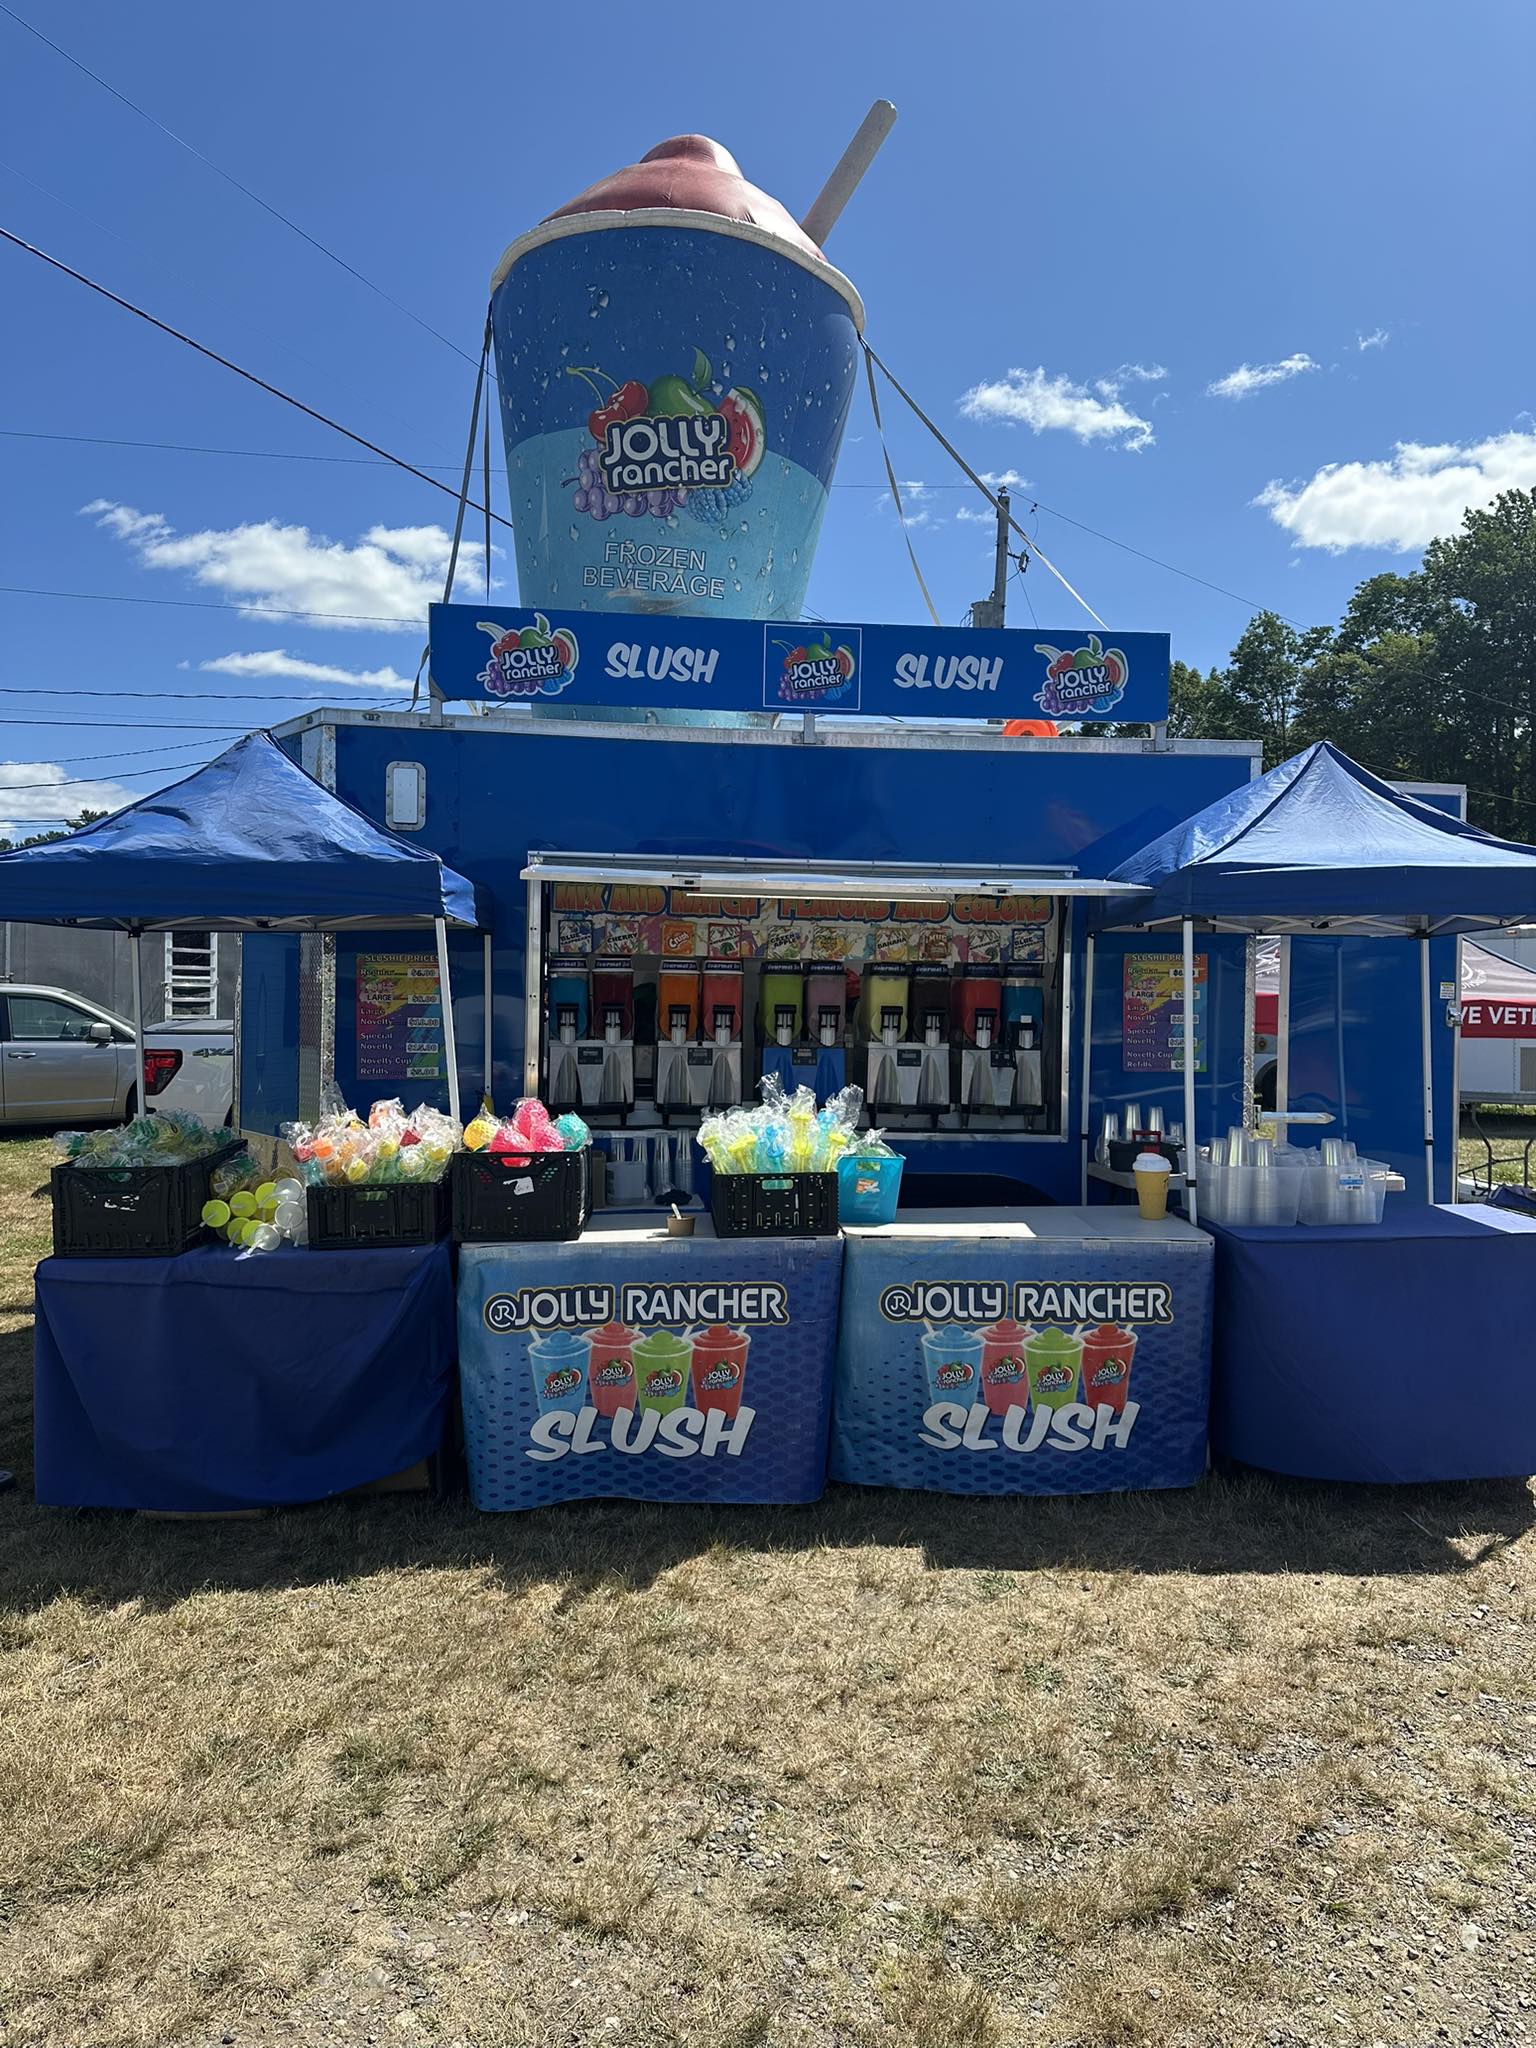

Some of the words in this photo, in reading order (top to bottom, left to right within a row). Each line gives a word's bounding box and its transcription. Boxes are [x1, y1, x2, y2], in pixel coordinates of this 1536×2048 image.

[605, 420, 720, 464] JOLLY
[612, 455, 730, 488] rancher
[604, 542, 706, 571] FROZEN
[583, 566, 725, 600] BEVERAGE
[501, 647, 556, 668] JOLLY
[604, 642, 720, 684] SLUSH
[505, 662, 560, 680] rancher
[789, 658, 838, 679] JOLLY
[893, 652, 1004, 691] SLUSH
[793, 673, 843, 691] rancher
[1055, 665, 1107, 688] JOLLY
[1059, 681, 1110, 699] rancher
[607, 885, 666, 912] AND
[895, 901, 949, 920] AND
[954, 894, 1050, 922] COLORS
[607, 933, 638, 943] CHERRY
[877, 937, 907, 949] BANANA
[360, 1017, 392, 1026] Novelty
[1127, 1014, 1156, 1023] Novelty
[360, 1032, 392, 1041] Special
[1127, 1027, 1156, 1036] Special
[360, 1043, 392, 1052] Novelty
[1127, 1038, 1156, 1046] Novelty
[1127, 1050, 1157, 1059] Novelty
[1157, 1051, 1173, 1060] Cup
[360, 1058, 392, 1066] Novelty
[395, 1057, 412, 1066] Cup
[360, 1067, 389, 1075] Refills
[514, 1290, 609, 1326] JOLLY
[626, 1287, 784, 1322] RANCHER
[910, 1286, 1002, 1318] JOLLY
[1018, 1286, 1169, 1319] RANCHER
[602, 1366, 624, 1376] JOLLY
[708, 1369, 731, 1380] JOLLY
[942, 1369, 965, 1380] JOLLY
[994, 1363, 1016, 1374] JOLLY
[1098, 1366, 1118, 1376] JOLLY
[550, 1375, 573, 1388] JOLLY
[651, 1376, 673, 1387] JOLLY
[1042, 1372, 1064, 1382] JOLLY
[552, 1381, 575, 1393] rancher
[918, 1401, 1141, 1452] SLUSH
[525, 1406, 757, 1462] SLUSH
